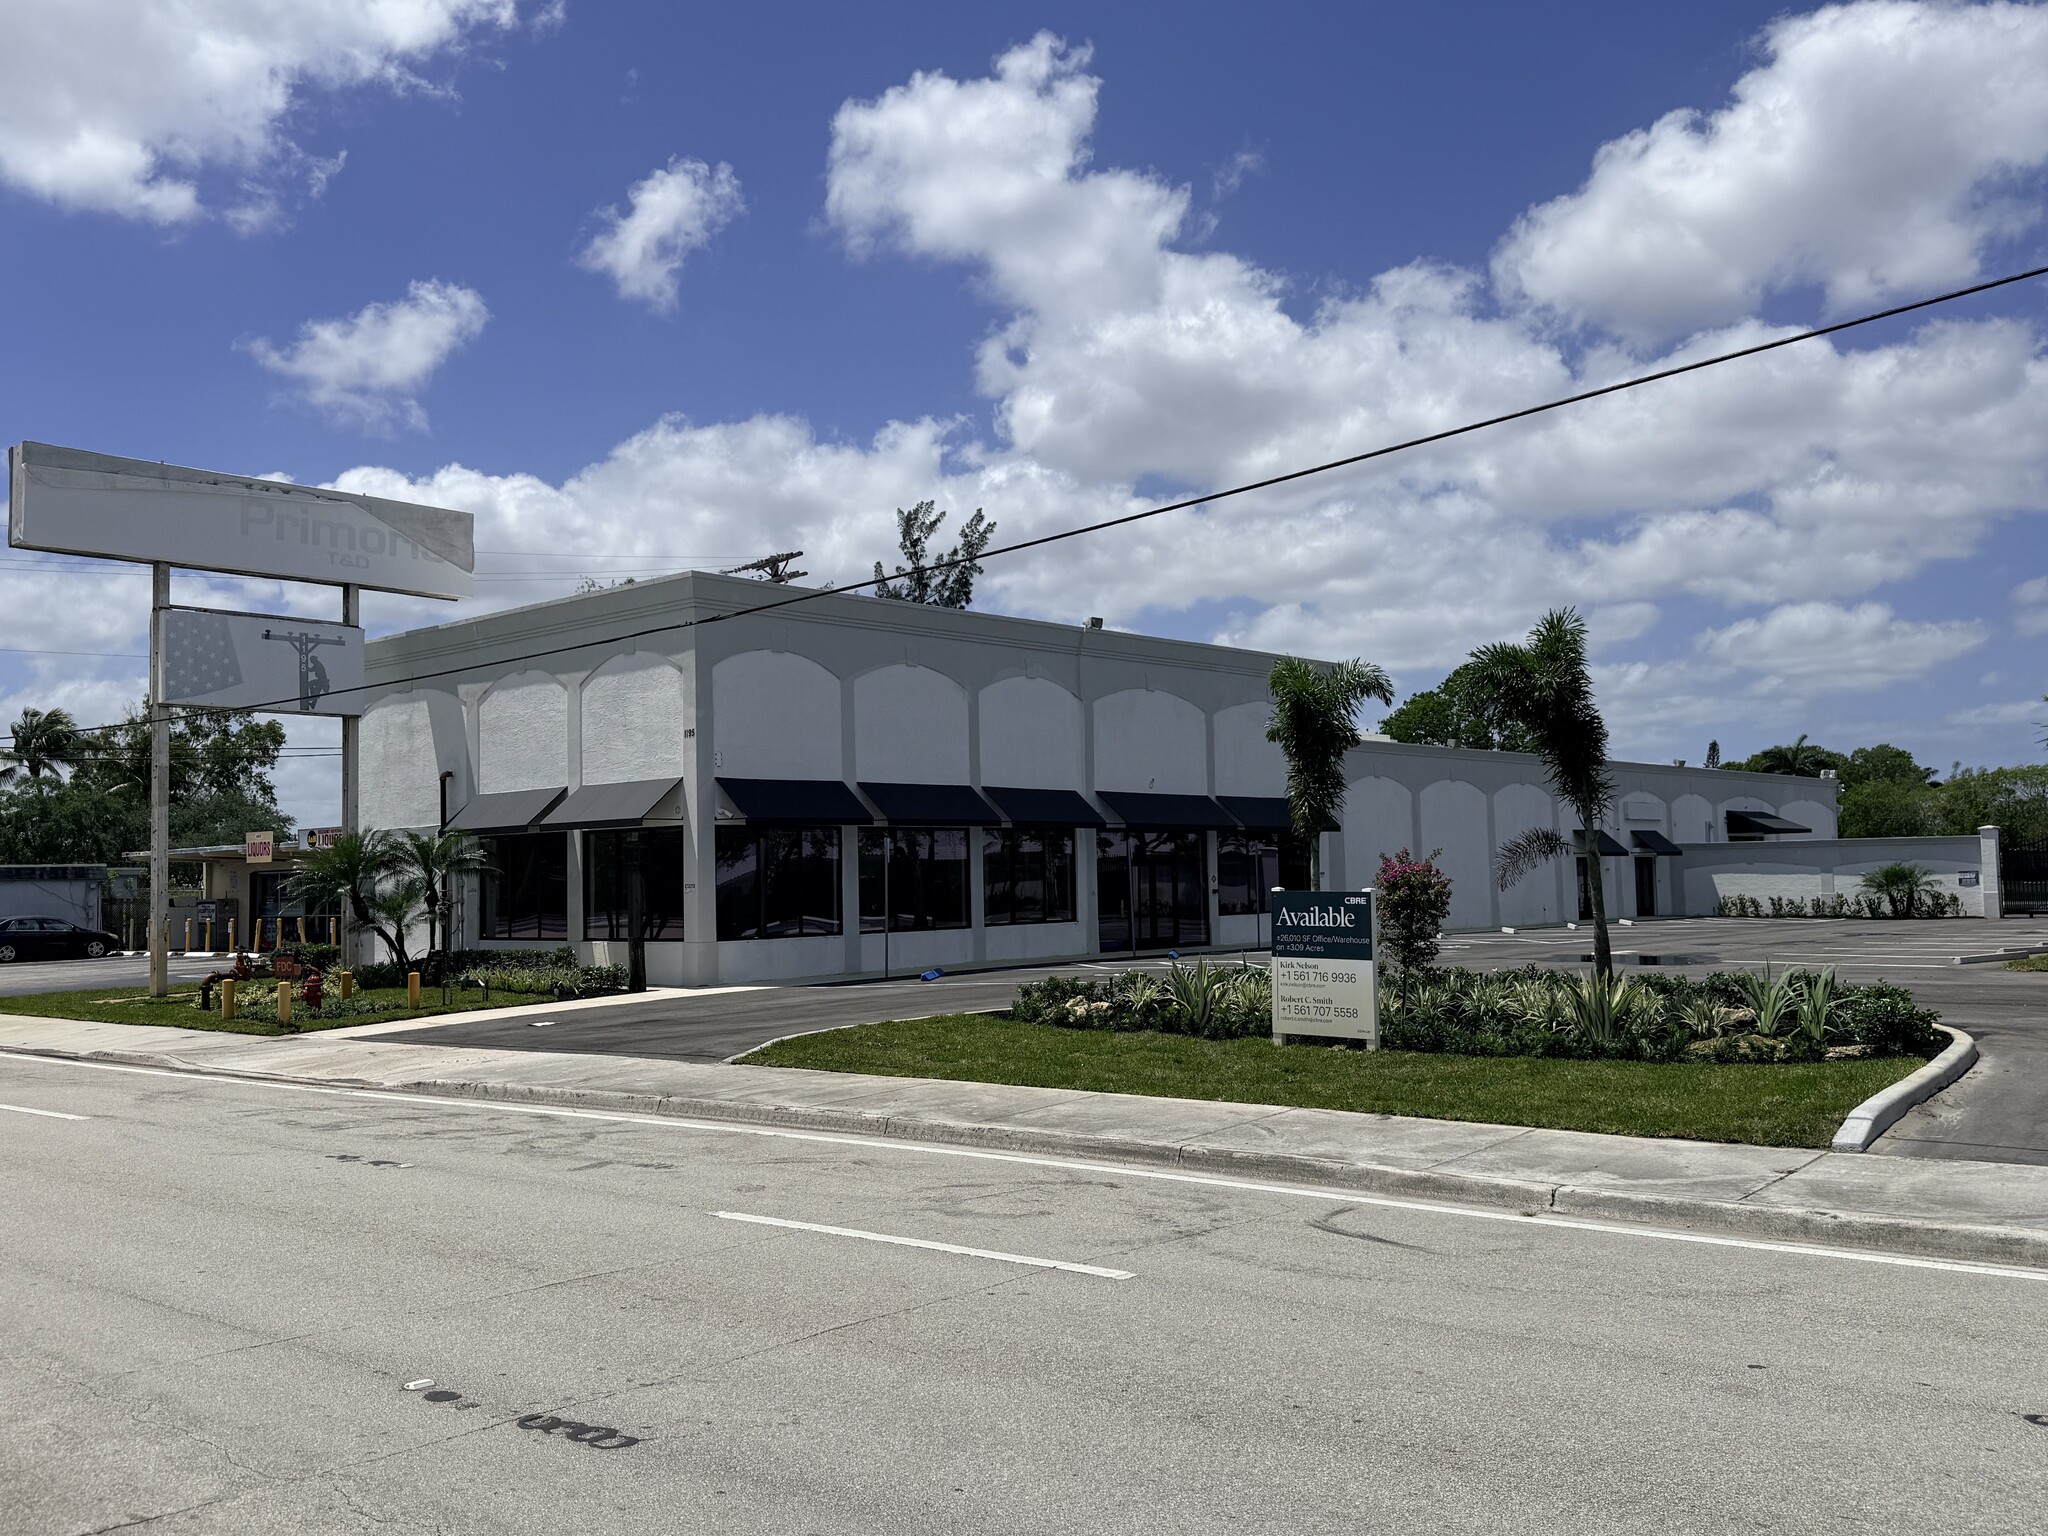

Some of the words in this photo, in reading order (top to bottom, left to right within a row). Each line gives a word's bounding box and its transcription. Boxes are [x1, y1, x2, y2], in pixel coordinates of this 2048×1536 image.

[240, 498, 445, 563] Primor
[327, 551, 370, 569] T&D
[684, 728, 696, 739] 1195
[247, 840, 271, 857] LIQUORS
[1344, 897, 1367, 905] CBRE
[1275, 905, 1356, 928] Available
[1302, 934, 1311, 942] SF
[1312, 934, 1370, 944] Office/Warehouse
[1305, 944, 1324, 952] Acres
[276, 961, 292, 972] FDC
[1280, 961, 1295, 969] Kirk
[1296, 962, 1319, 970] Nelson
[1281, 970, 1291, 980] +1
[1293, 971, 1310, 981] 561
[1313, 971, 1329, 982] 716
[1331, 972, 1357, 983] 9936
[1280, 995, 1303, 1003] Robert
[1304, 996, 1312, 1004] C.
[1312, 997, 1333, 1005] Smith
[1281, 1004, 1291, 1014] +1
[1294, 1005, 1310, 1015] 561
[1313, 1006, 1331, 1017] 707
[1334, 1007, 1359, 1019] 5558
